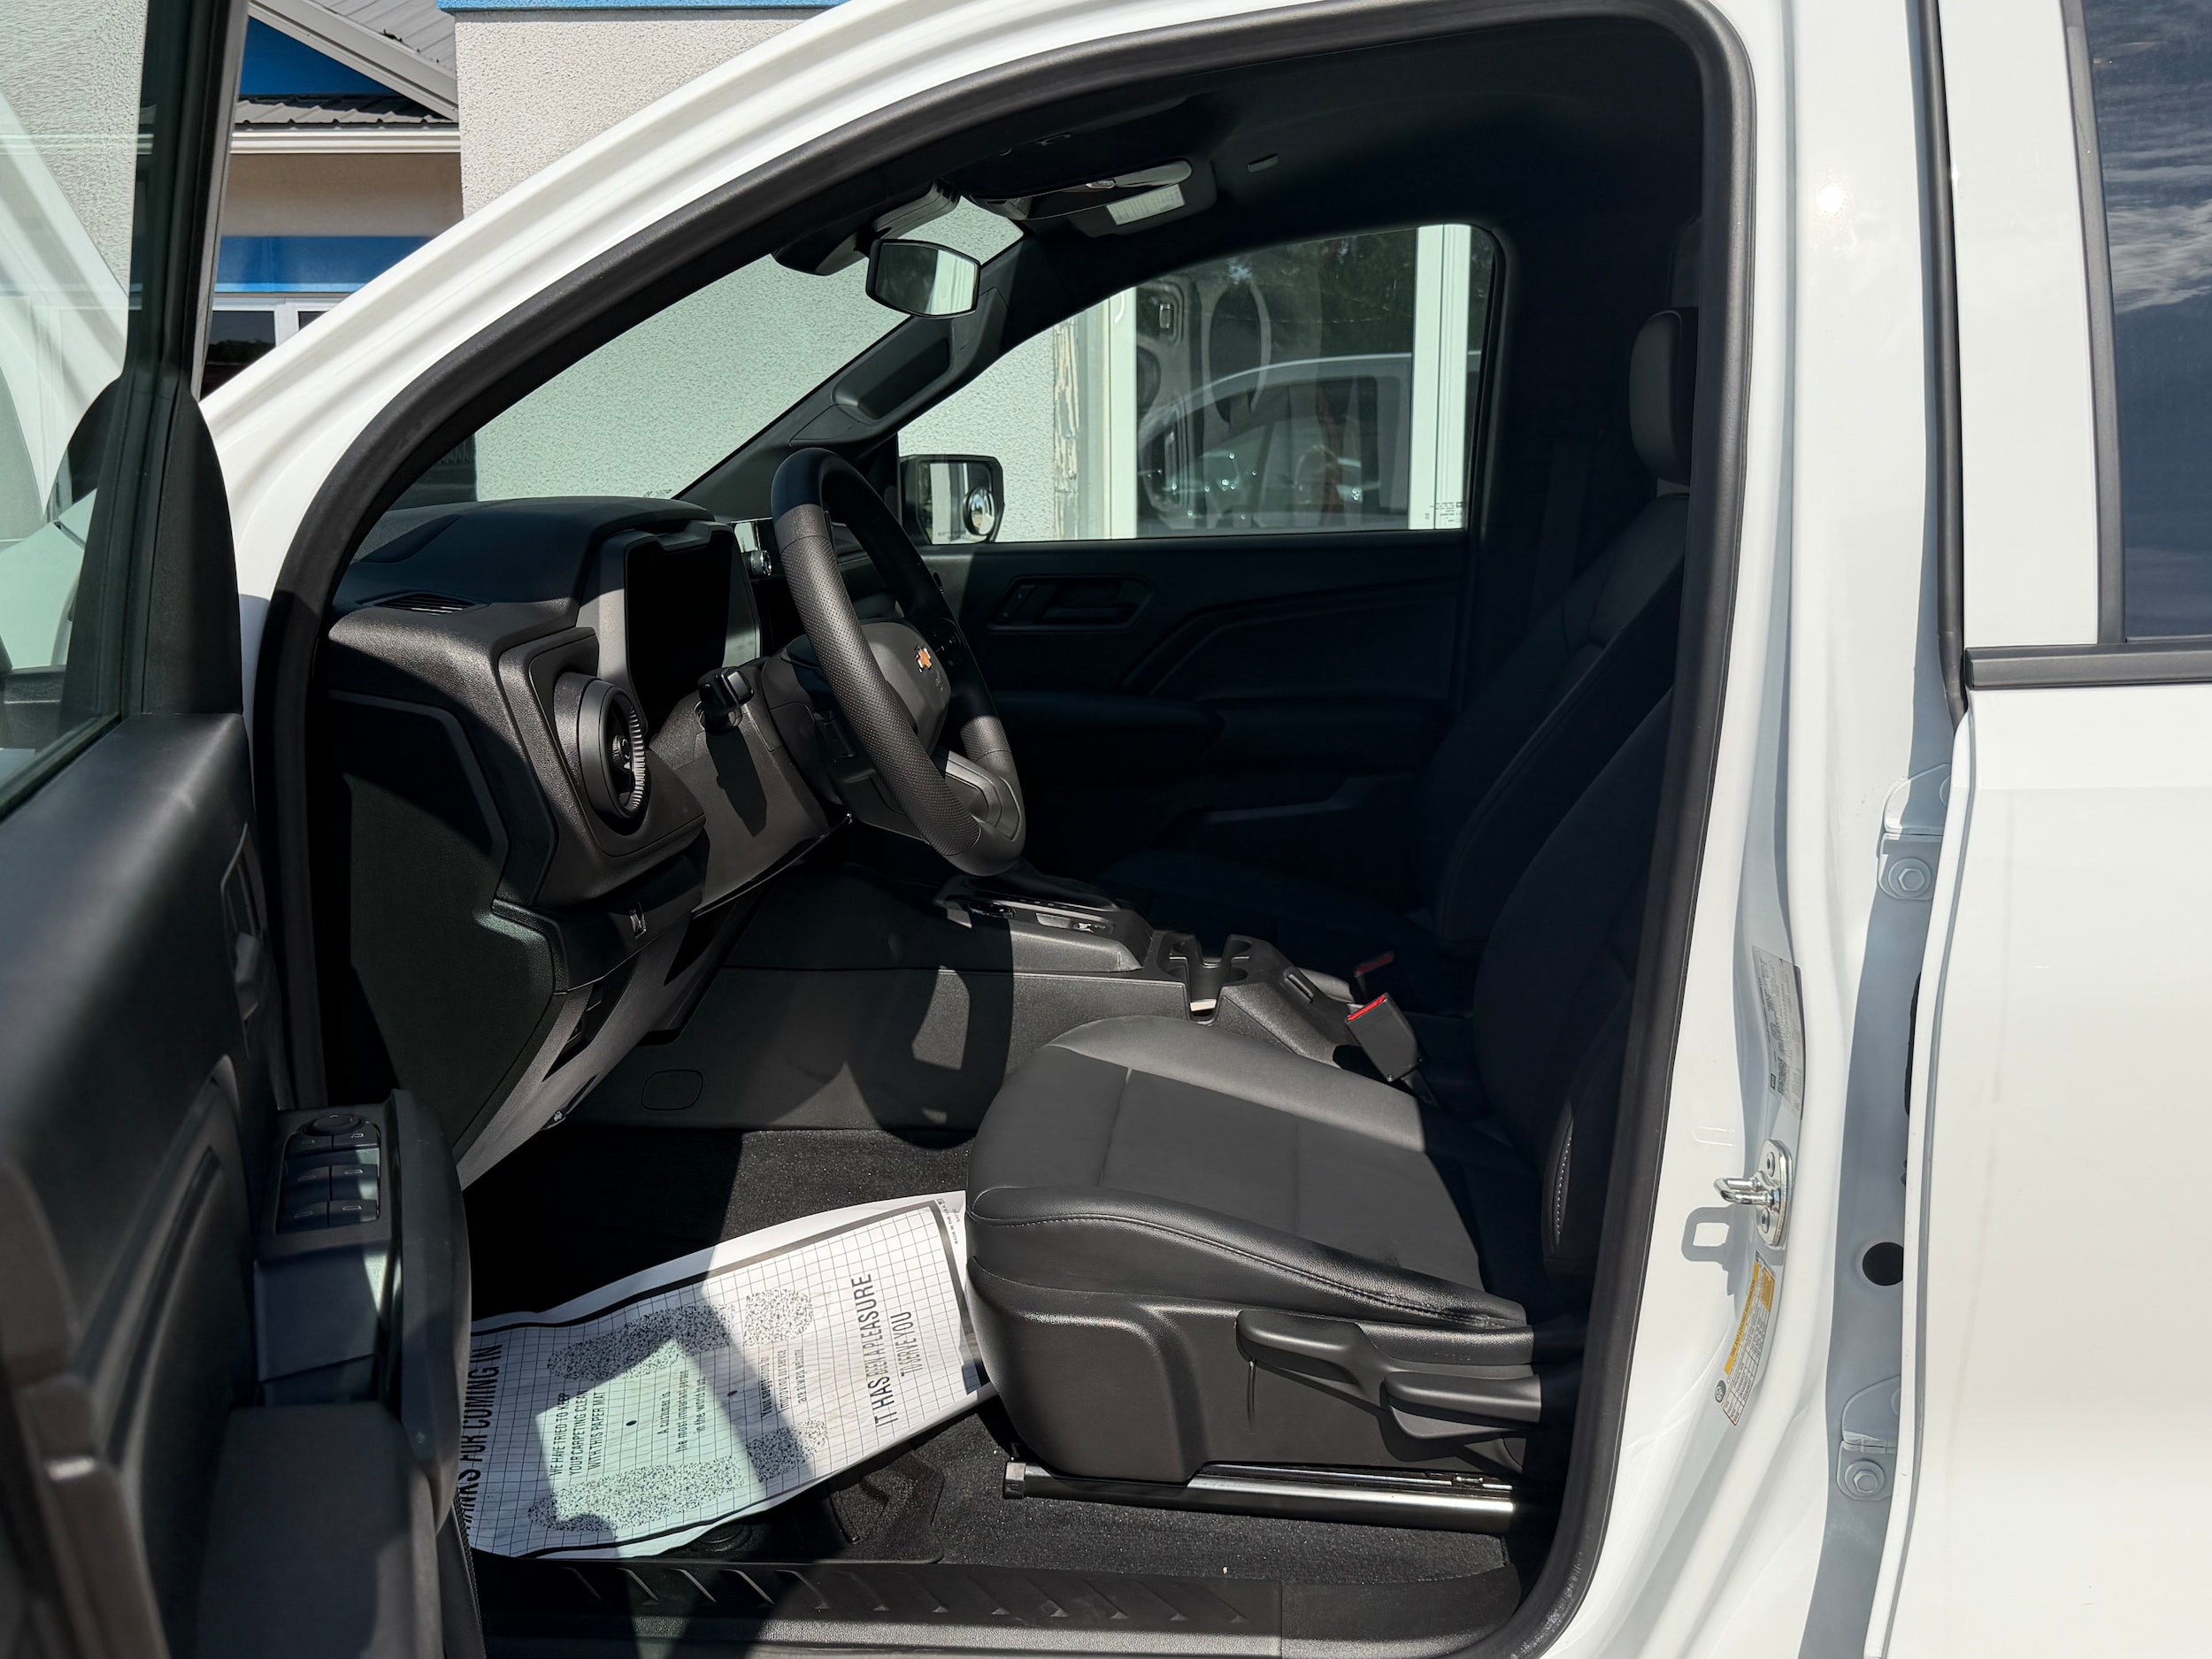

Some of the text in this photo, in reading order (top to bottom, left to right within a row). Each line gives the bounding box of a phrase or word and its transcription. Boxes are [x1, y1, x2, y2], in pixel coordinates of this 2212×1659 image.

[470, 1344, 503, 1363] IN
[851, 1273, 899, 1427] IT HAS BEEN A PLEASURE
[890, 1311, 922, 1377] TO SERVE YOU
[463, 1366, 499, 1429] COMING
[675, 1388, 690, 1420] important
[760, 1399, 772, 1417] Your
[796, 1391, 807, 1403] are
[569, 1390, 588, 1475] YOUR CARPETING CLEAN
[588, 1392, 606, 1470] WITH THIS PAPER MAT
[675, 1420, 687, 1438] most
[695, 1413, 706, 1425] the
[460, 1435, 487, 1462] FOR
[549, 1393, 570, 1476] WE HAVE TRIED TO KEEP
[675, 1440, 687, 1452] the
